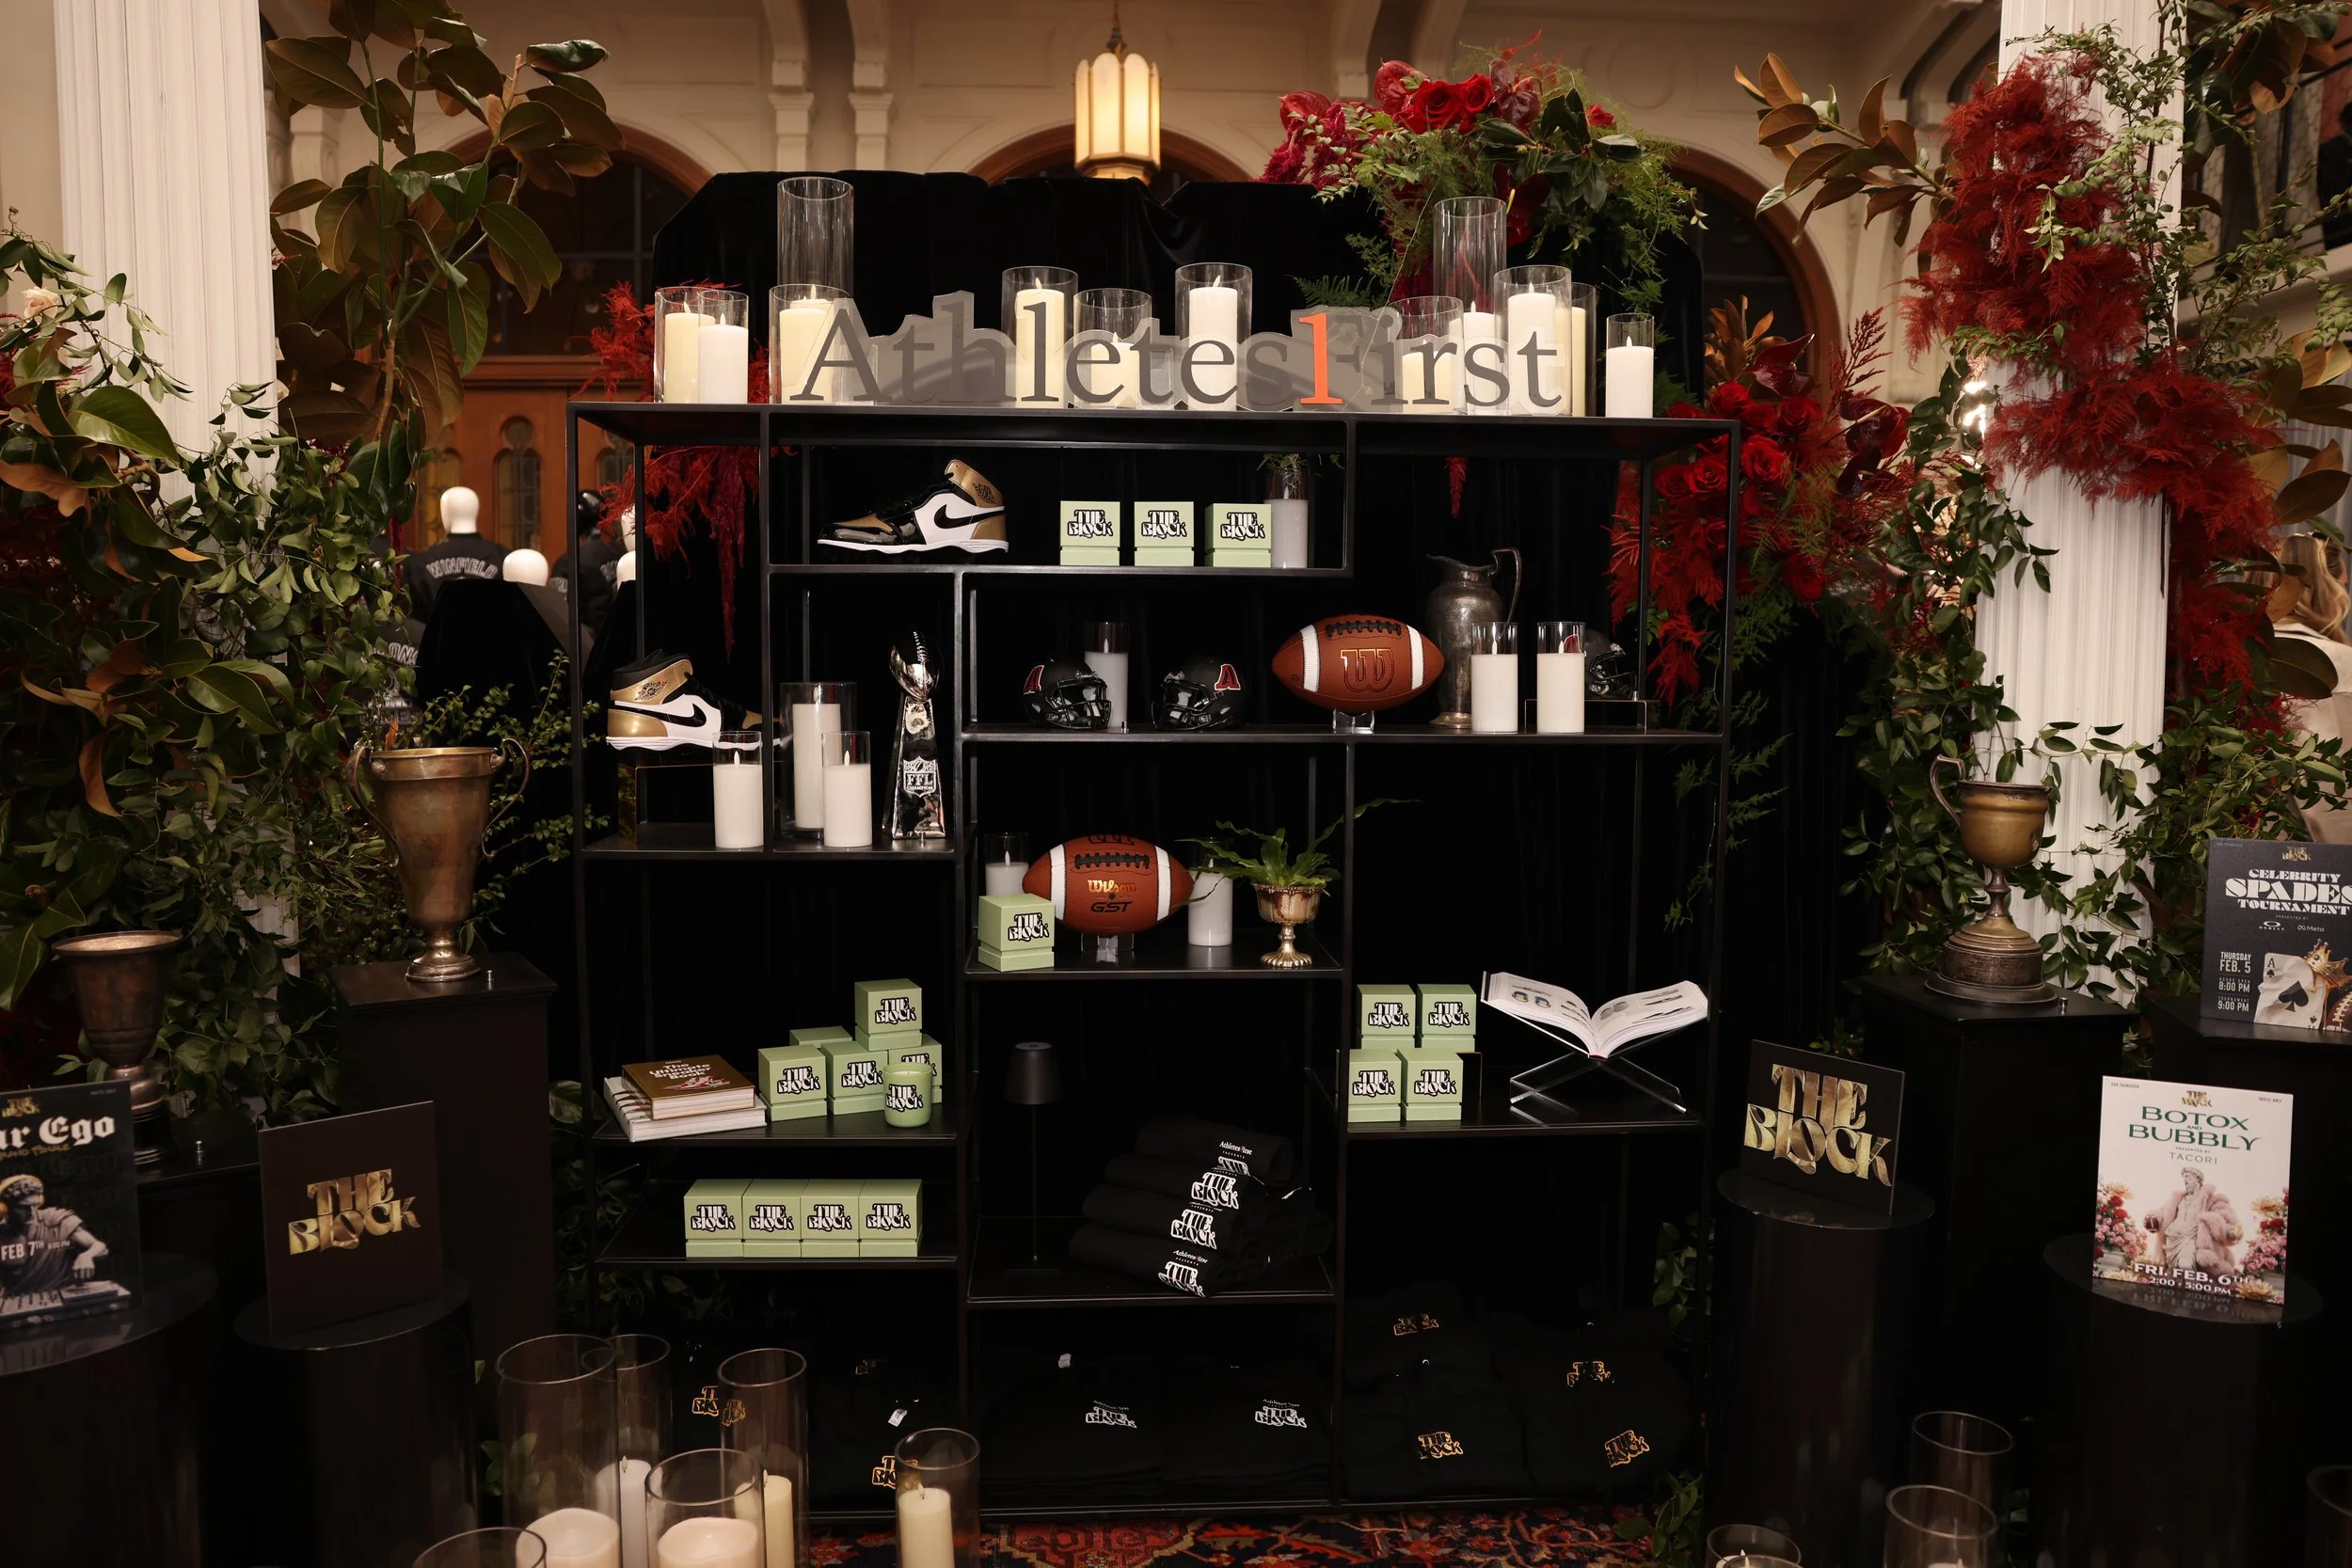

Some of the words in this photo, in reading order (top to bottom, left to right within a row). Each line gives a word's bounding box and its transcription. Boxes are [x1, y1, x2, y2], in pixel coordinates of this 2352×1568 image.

[1074, 510, 1104, 525] THE
[1149, 511, 1179, 526] THE
[1228, 513, 1257, 528] THE
[1068, 521, 1113, 538] BLOCK
[1142, 522, 1186, 539] BLOCK
[1221, 524, 1264, 541] BLOCK
[1215, 663, 1241, 690] A
[907, 773, 933, 785] FFL
[2249, 868, 2341, 883] CELEBRITY
[1088, 879, 1137, 894] Wilson
[2225, 878, 2352, 906] SPADES
[1090, 901, 1134, 913] GST
[2237, 898, 2350, 916] TOURNAMENT
[1014, 912, 1041, 927] THE
[1009, 924, 1049, 942] BLOCK
[2220, 951, 2251, 961] THURSDAY
[2267, 958, 2276, 968] A
[2219, 959, 2241, 974] FEB.
[2245, 961, 2251, 974] 5
[2218, 981, 2236, 991] 8:00
[2238, 983, 2250, 993] PM
[882, 997, 909, 1011] THE
[1375, 1003, 1402, 1016] THE
[1435, 1002, 1462, 1015] THE
[2217, 1001, 2235, 1011] 9:00
[2237, 1003, 2249, 1012] PM
[875, 1007, 916, 1024] BLOCK
[1368, 1013, 1409, 1028] BLOCK
[1428, 1012, 1470, 1027] BLOCK
[784, 1067, 813, 1081] THE
[849, 1061, 876, 1075] THE
[842, 1071, 883, 1088] BLOCK
[1359, 1070, 1388, 1085] THE
[1421, 1069, 1449, 1084] THE
[777, 1077, 820, 1094] BLOCK
[891, 1084, 916, 1099] THE
[1353, 1081, 1395, 1098] BLOCK
[1414, 1080, 1456, 1096] BLOCK
[1771, 1063, 1868, 1131] THE
[2185, 1090, 2208, 1100] THE
[885, 1095, 923, 1112] BLOCK
[2141, 1105, 2249, 1131] BOTOX
[40, 1116, 116, 1147] Ego
[2128, 1123, 2263, 1151] BUBBLY
[1743, 1102, 1893, 1187] BLOCK
[2169, 1151, 2217, 1165] TACORI
[1202, 1171, 1236, 1192] THE
[308, 1168, 393, 1216] THE
[1191, 1181, 1239, 1210] BLOCK
[697, 1205, 727, 1219] THE
[756, 1205, 787, 1219] THE
[814, 1205, 844, 1219] THE
[873, 1204, 903, 1218] THE
[1182, 1209, 1214, 1229] THE
[288, 1196, 421, 1256] BLOCK
[691, 1215, 735, 1232] BLOCK
[750, 1215, 794, 1232] BLOCK
[807, 1215, 851, 1231] BLOCK
[866, 1214, 911, 1230] BLOCK
[1170, 1219, 1217, 1249] BLOCK
[1, 1243, 24, 1261] FEB
[27, 1240, 44, 1257] 7TH
[1165, 1260, 1199, 1285] THE
[2134, 1262, 2169, 1277] FRI.
[2172, 1268, 2214, 1284] FEB.
[2217, 1274, 2249, 1287] 6TH
[2148, 1276, 2175, 1288] 2:00
[2185, 1283, 2212, 1294] 5:00
[2213, 1286, 2233, 1296] PM
[1418, 1432, 1452, 1447] THE
